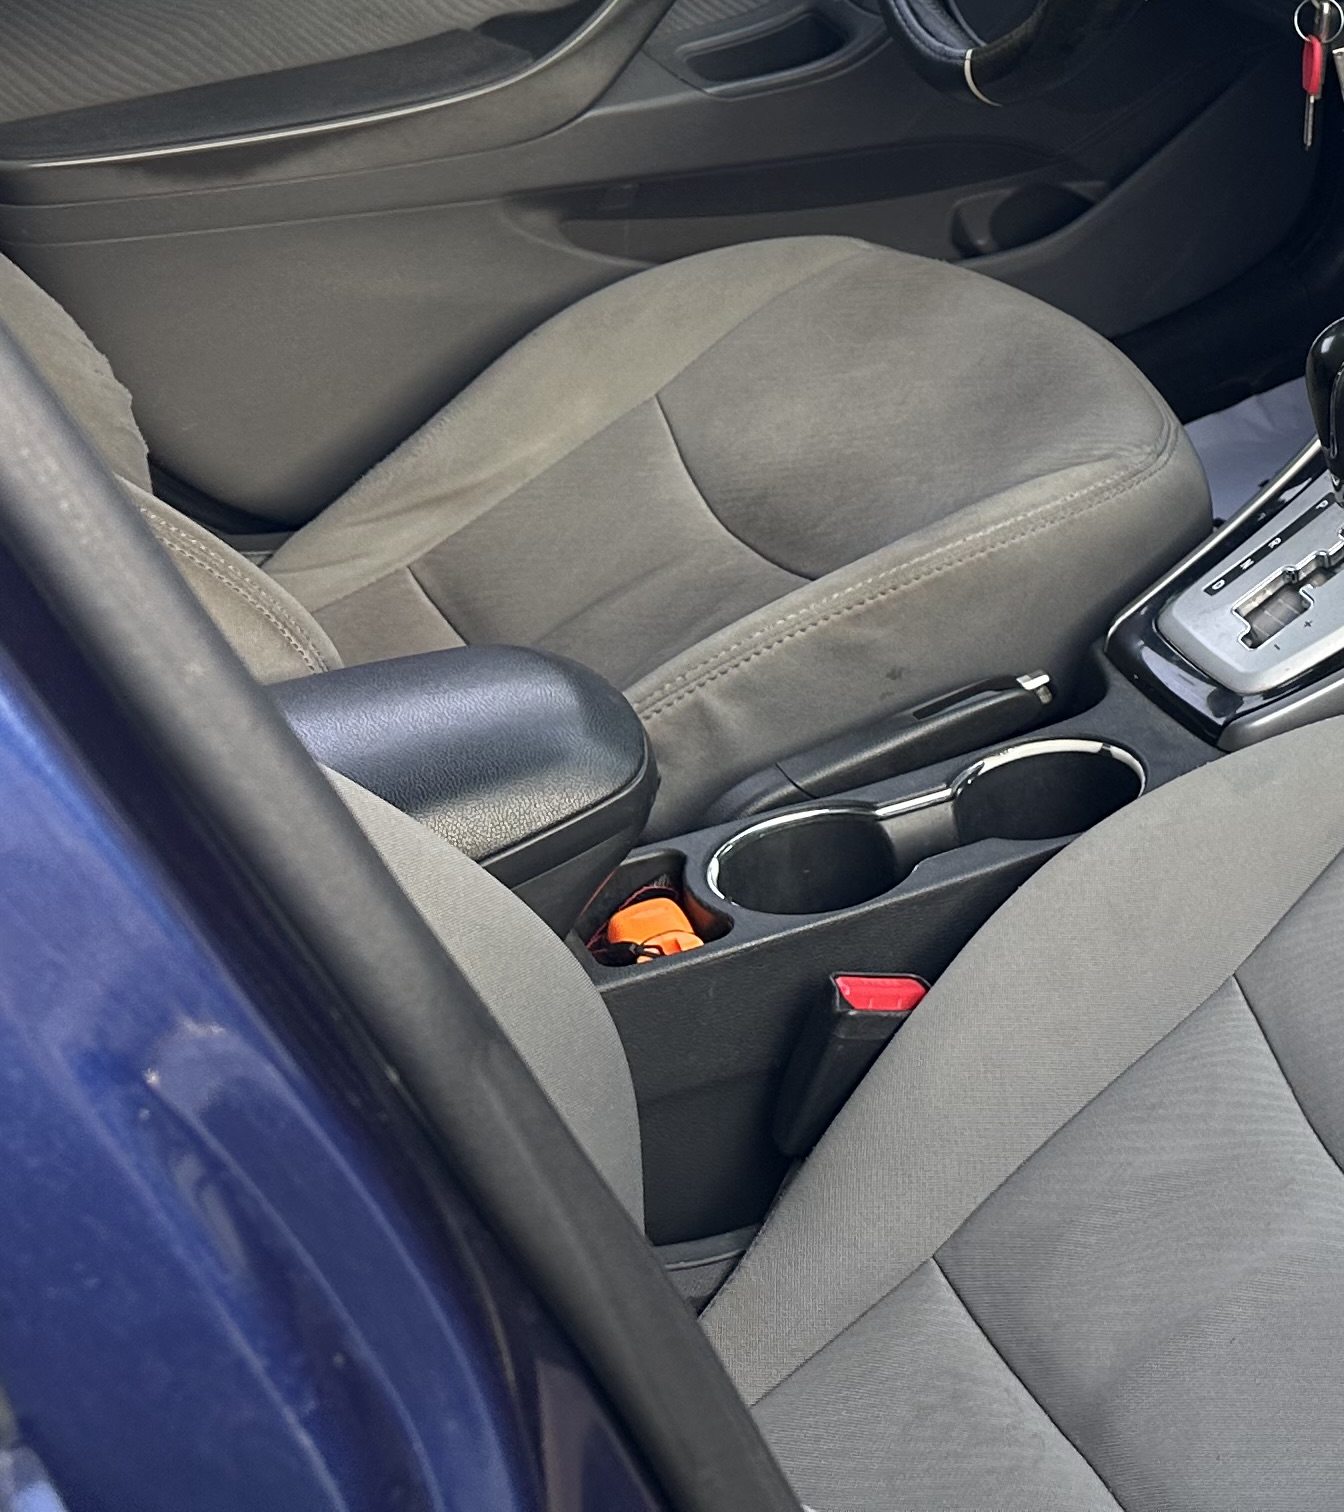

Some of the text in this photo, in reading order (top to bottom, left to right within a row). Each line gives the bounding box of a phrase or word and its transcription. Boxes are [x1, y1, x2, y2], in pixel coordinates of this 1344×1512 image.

[1211, 499, 1329, 590] P R N D
